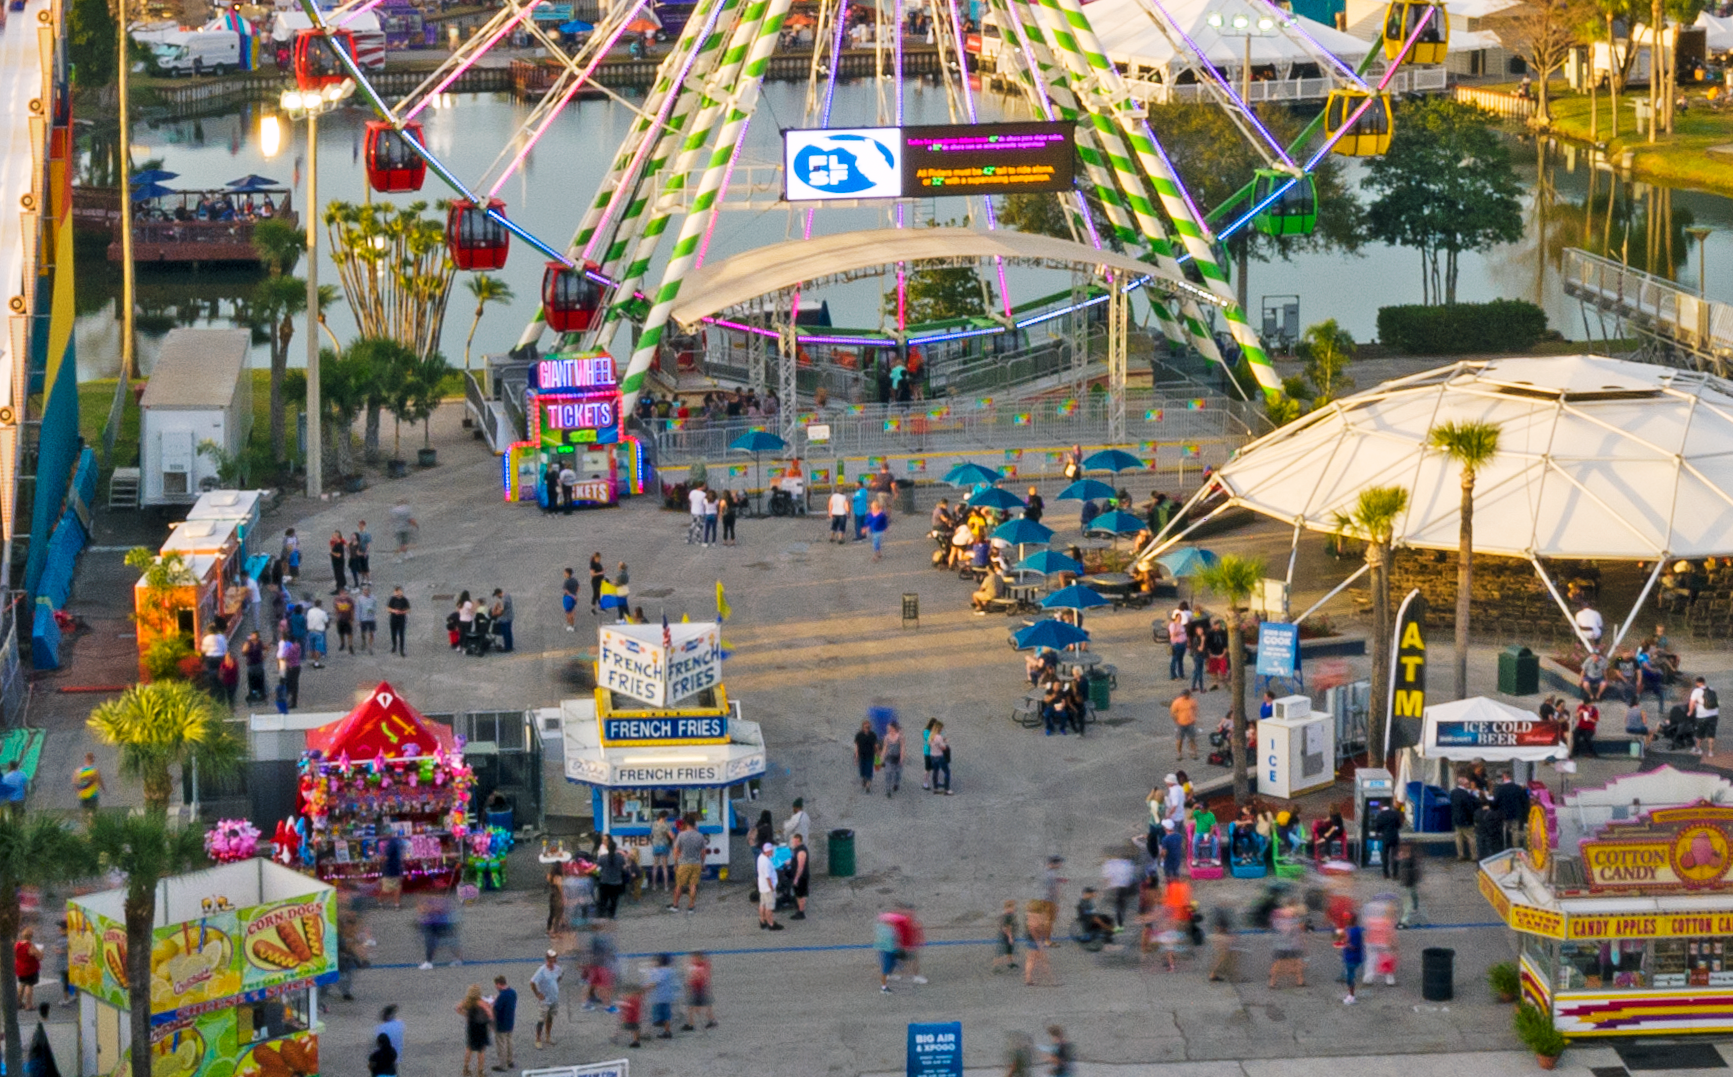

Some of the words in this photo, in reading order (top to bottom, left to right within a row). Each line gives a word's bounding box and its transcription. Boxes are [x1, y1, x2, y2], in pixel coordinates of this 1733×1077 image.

[809, 154, 848, 170] FL
[953, 168, 972, 176] must
[972, 167, 983, 176] be
[808, 169, 848, 186] SF
[539, 358, 574, 390] GIANT
[574, 357, 617, 387] WHEEL
[547, 402, 611, 429] TICKETS
[572, 483, 608, 502] KETS
[602, 646, 663, 683] FRENCH
[667, 642, 720, 678] FRENCH
[1394, 621, 1426, 718] ATM
[608, 669, 656, 700] FRIES
[672, 666, 715, 700] FRIES
[610, 719, 671, 738] FRENCH
[678, 719, 720, 737] FRIES
[1464, 721, 1489, 733] ICE
[1492, 721, 1533, 734] COLD
[1477, 733, 1518, 745] BEER
[1268, 738, 1277, 783] ICE
[619, 767, 673, 781] FRENCH
[677, 766, 715, 779] FRIES
[1595, 849, 1665, 866] COTTON
[1599, 865, 1660, 881] CANDY
[247, 911, 285, 936] CORN
[287, 902, 323, 923] DOGS
[1573, 921, 1611, 937] CANDY
[1614, 919, 1657, 936] APPLES
[1671, 918, 1713, 934] COTTON
[175, 992, 246, 1019] CHEESE
[266, 975, 316, 998] STICK
[915, 1033, 935, 1044] BIG
[937, 1033, 956, 1043] AIR
